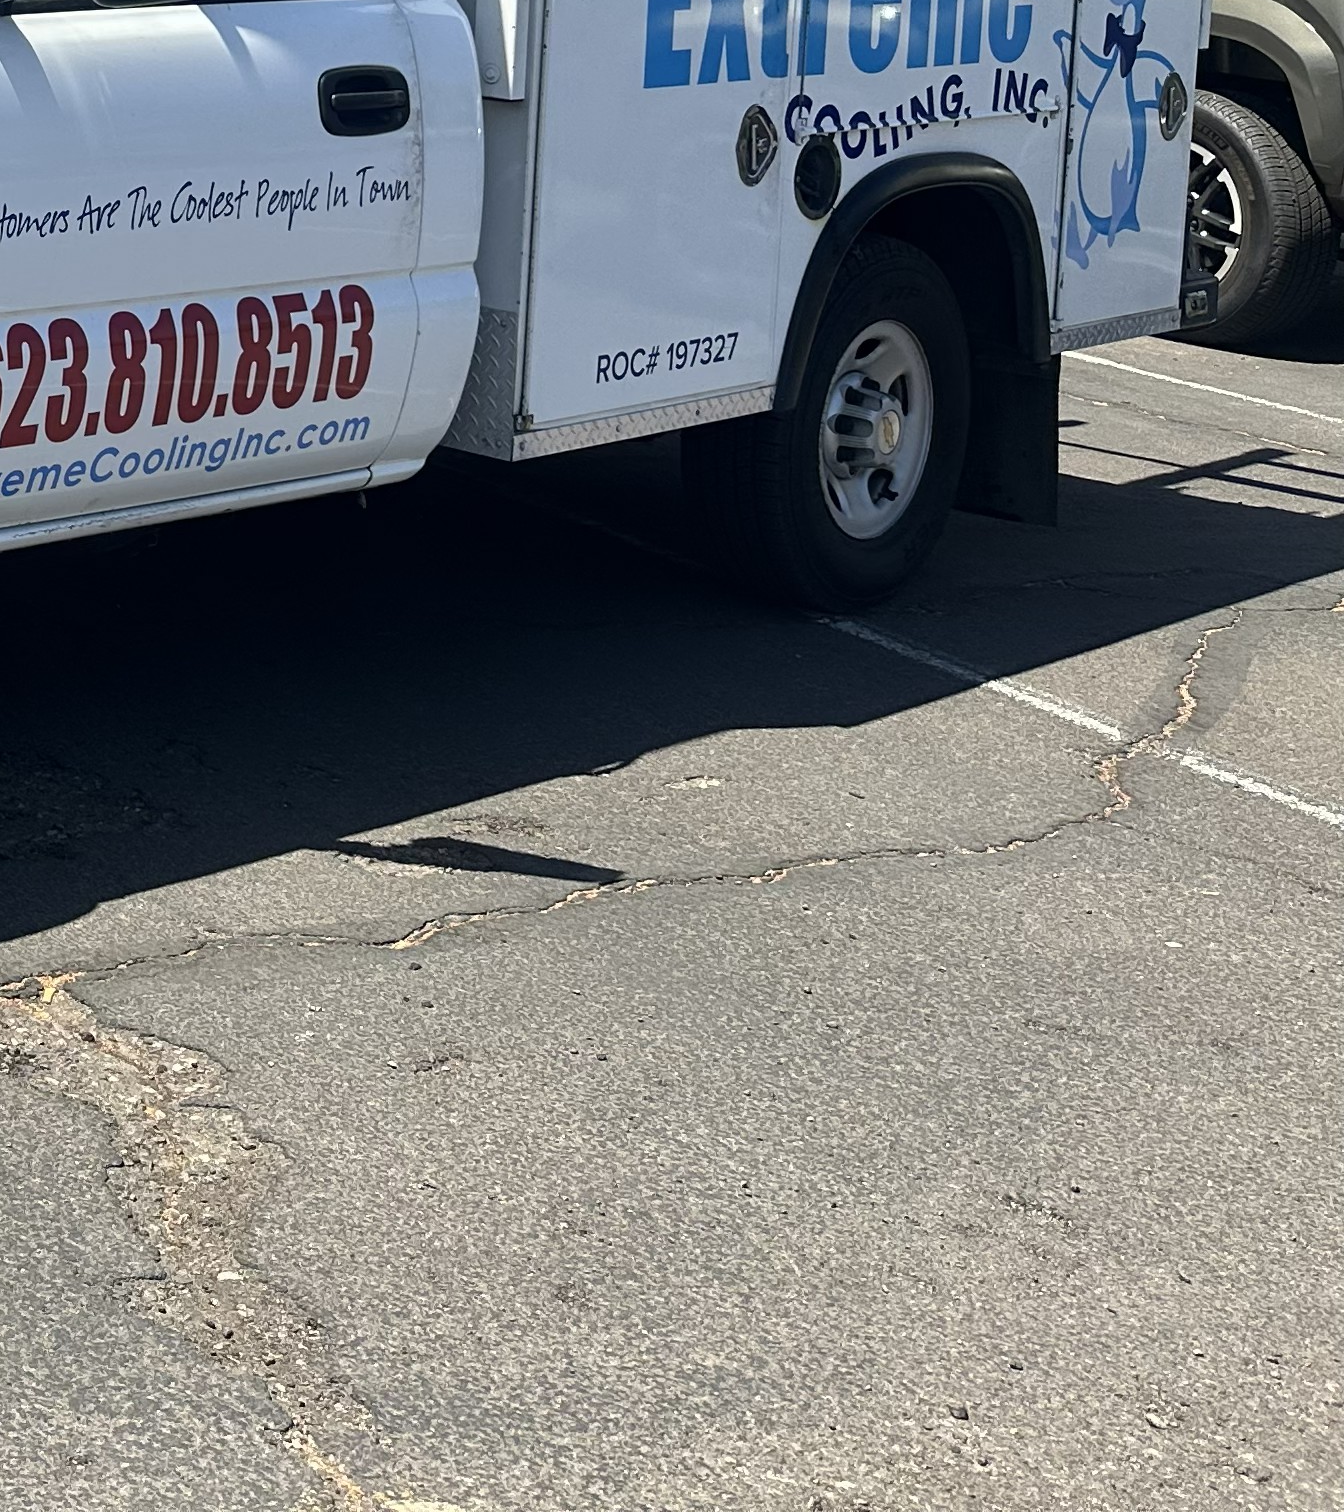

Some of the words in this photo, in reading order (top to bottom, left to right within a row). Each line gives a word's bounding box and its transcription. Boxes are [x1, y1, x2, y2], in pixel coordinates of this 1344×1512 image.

[991, 67, 1050, 130] INC.
[77, 194, 121, 234] Are
[127, 186, 162, 230] The
[170, 179, 249, 224] Coolest
[256, 178, 319, 231] People
[326, 171, 349, 212] In
[356, 165, 412, 208] Town
[596, 344, 661, 384] ROC#
[666, 331, 739, 371] 197327
